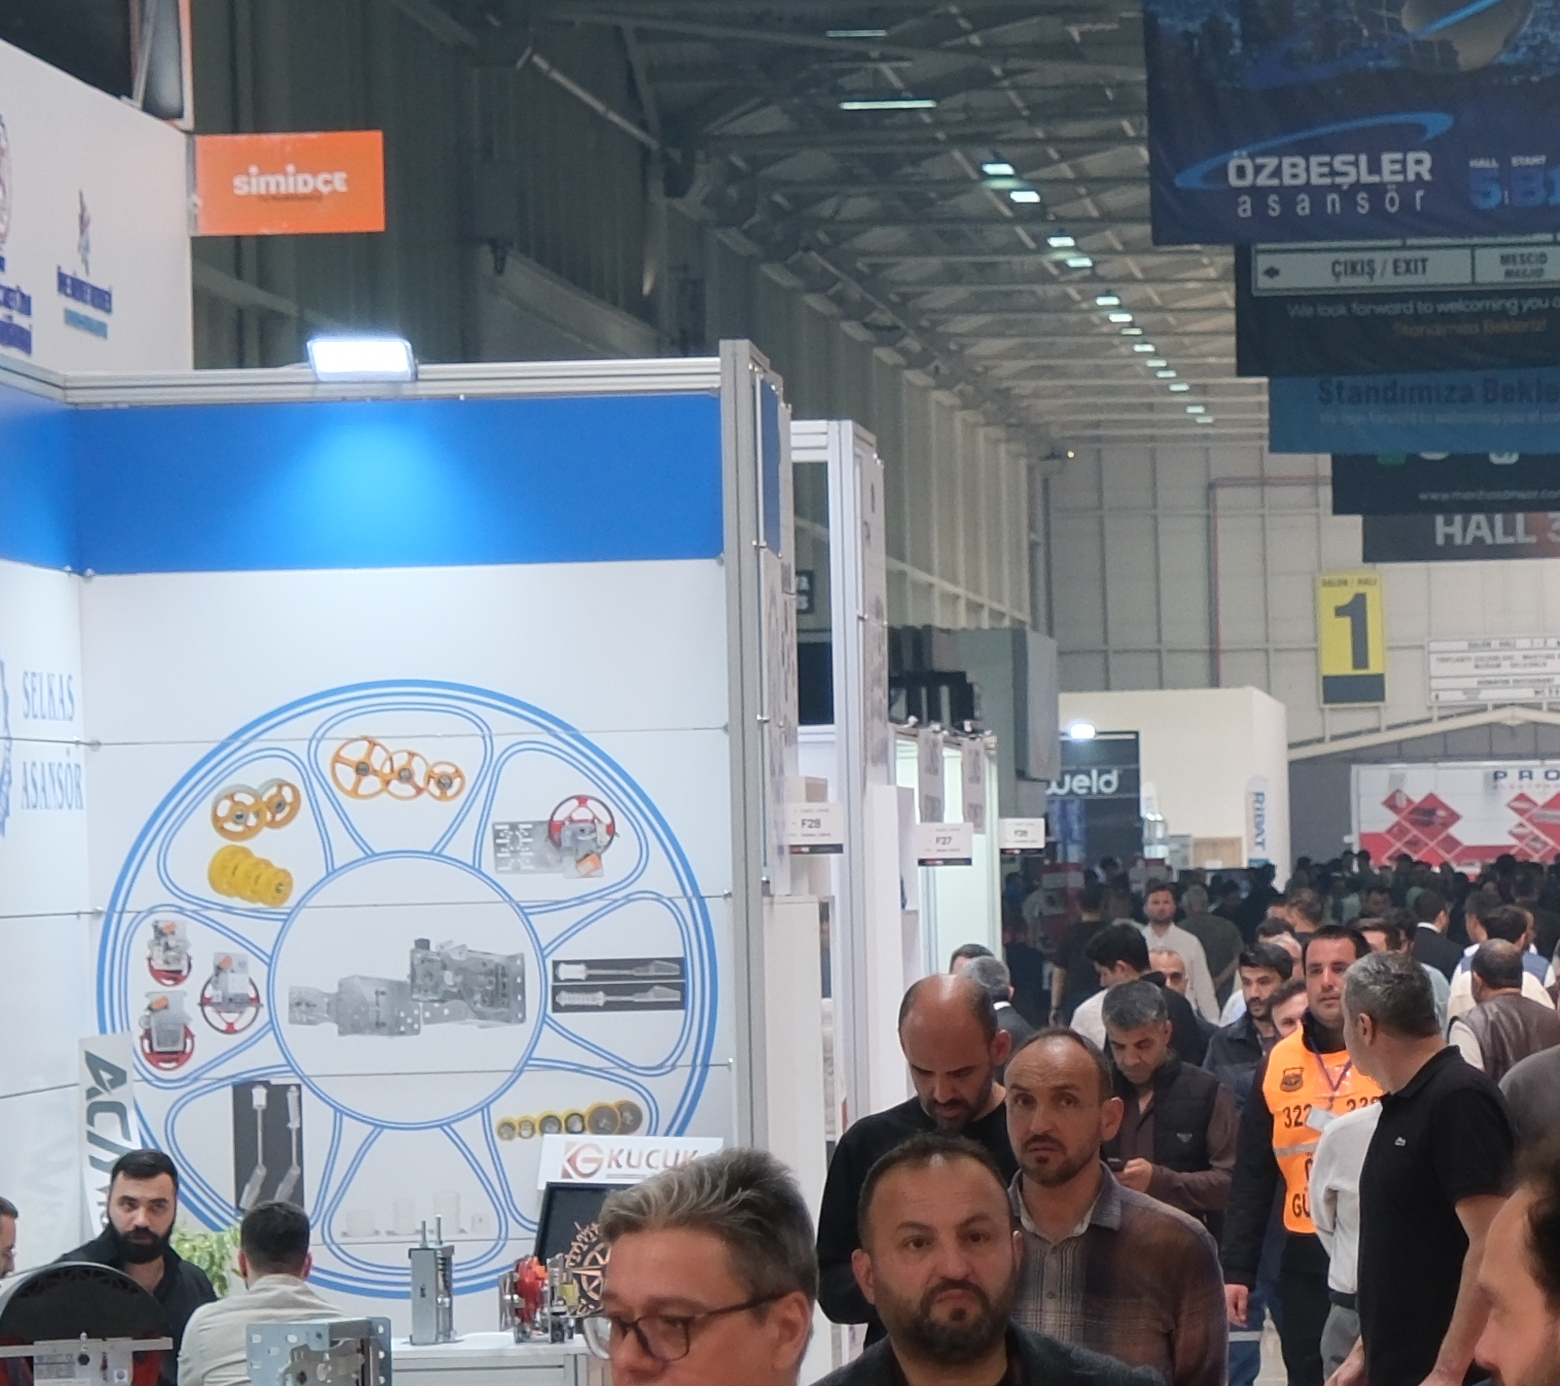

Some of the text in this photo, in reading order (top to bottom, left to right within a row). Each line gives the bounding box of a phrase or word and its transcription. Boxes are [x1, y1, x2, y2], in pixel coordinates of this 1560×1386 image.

[1226, 150, 1433, 190] ÖZBEŞLER
[1392, 256, 1429, 277] EXIT
[1435, 513, 1537, 547] HALL
[1334, 592, 1369, 671] 1
[22, 670, 75, 722] SELKAS
[20, 746, 84, 811] ASANSÖR
